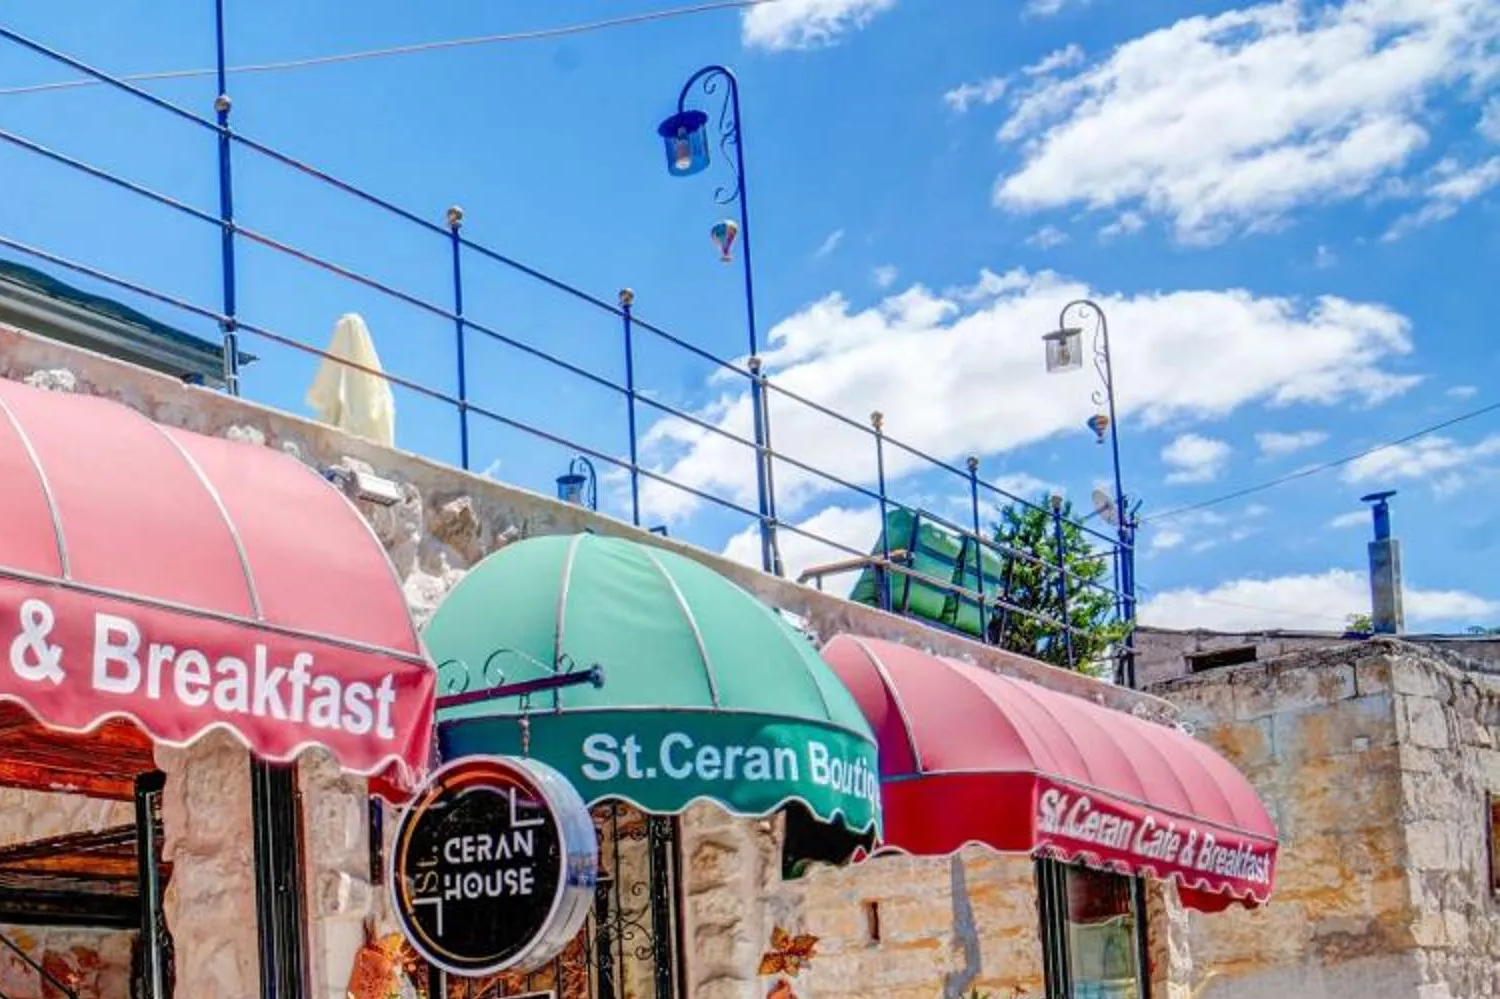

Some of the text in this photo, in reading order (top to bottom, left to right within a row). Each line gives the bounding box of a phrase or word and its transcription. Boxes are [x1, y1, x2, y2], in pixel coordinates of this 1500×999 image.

[8, 598, 67, 686] &
[91, 611, 397, 740] Breakfast
[580, 731, 800, 783] St.Ceran
[443, 828, 534, 864] CERAN
[1039, 788, 1271, 885] St.Ceran Cafe & Breakfast
[443, 866, 535, 901] HOUSE
